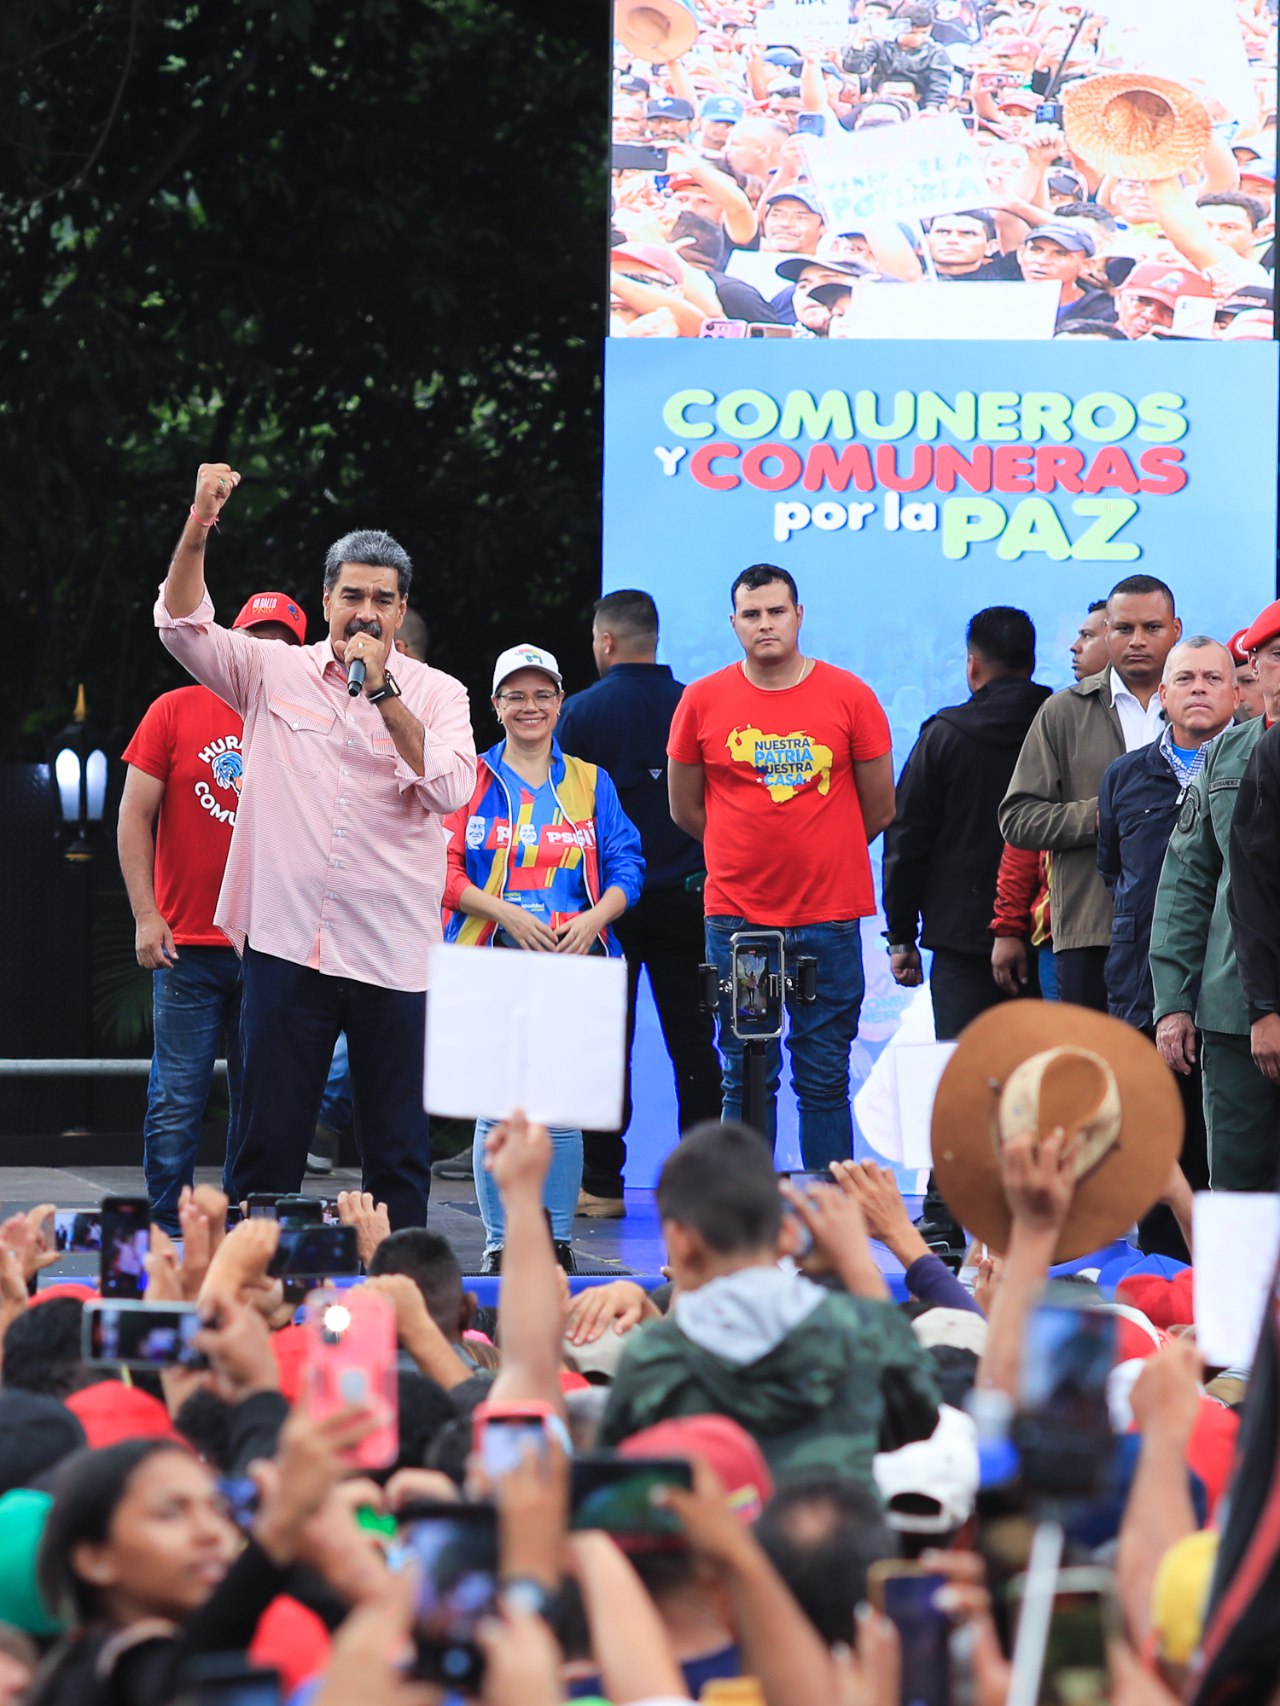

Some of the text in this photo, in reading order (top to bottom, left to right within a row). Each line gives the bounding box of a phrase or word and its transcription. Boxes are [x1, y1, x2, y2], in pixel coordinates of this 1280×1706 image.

[663, 389, 1189, 442] COMUNEROS
[655, 442, 1189, 495] Y COMUNERAS
[774, 492, 1142, 561] por la PAZ
[755, 738, 811, 750] NUESTRA
[755, 748, 814, 765] PATRIA
[755, 762, 814, 774] NUESTRA
[763, 773, 805, 786] CASA
